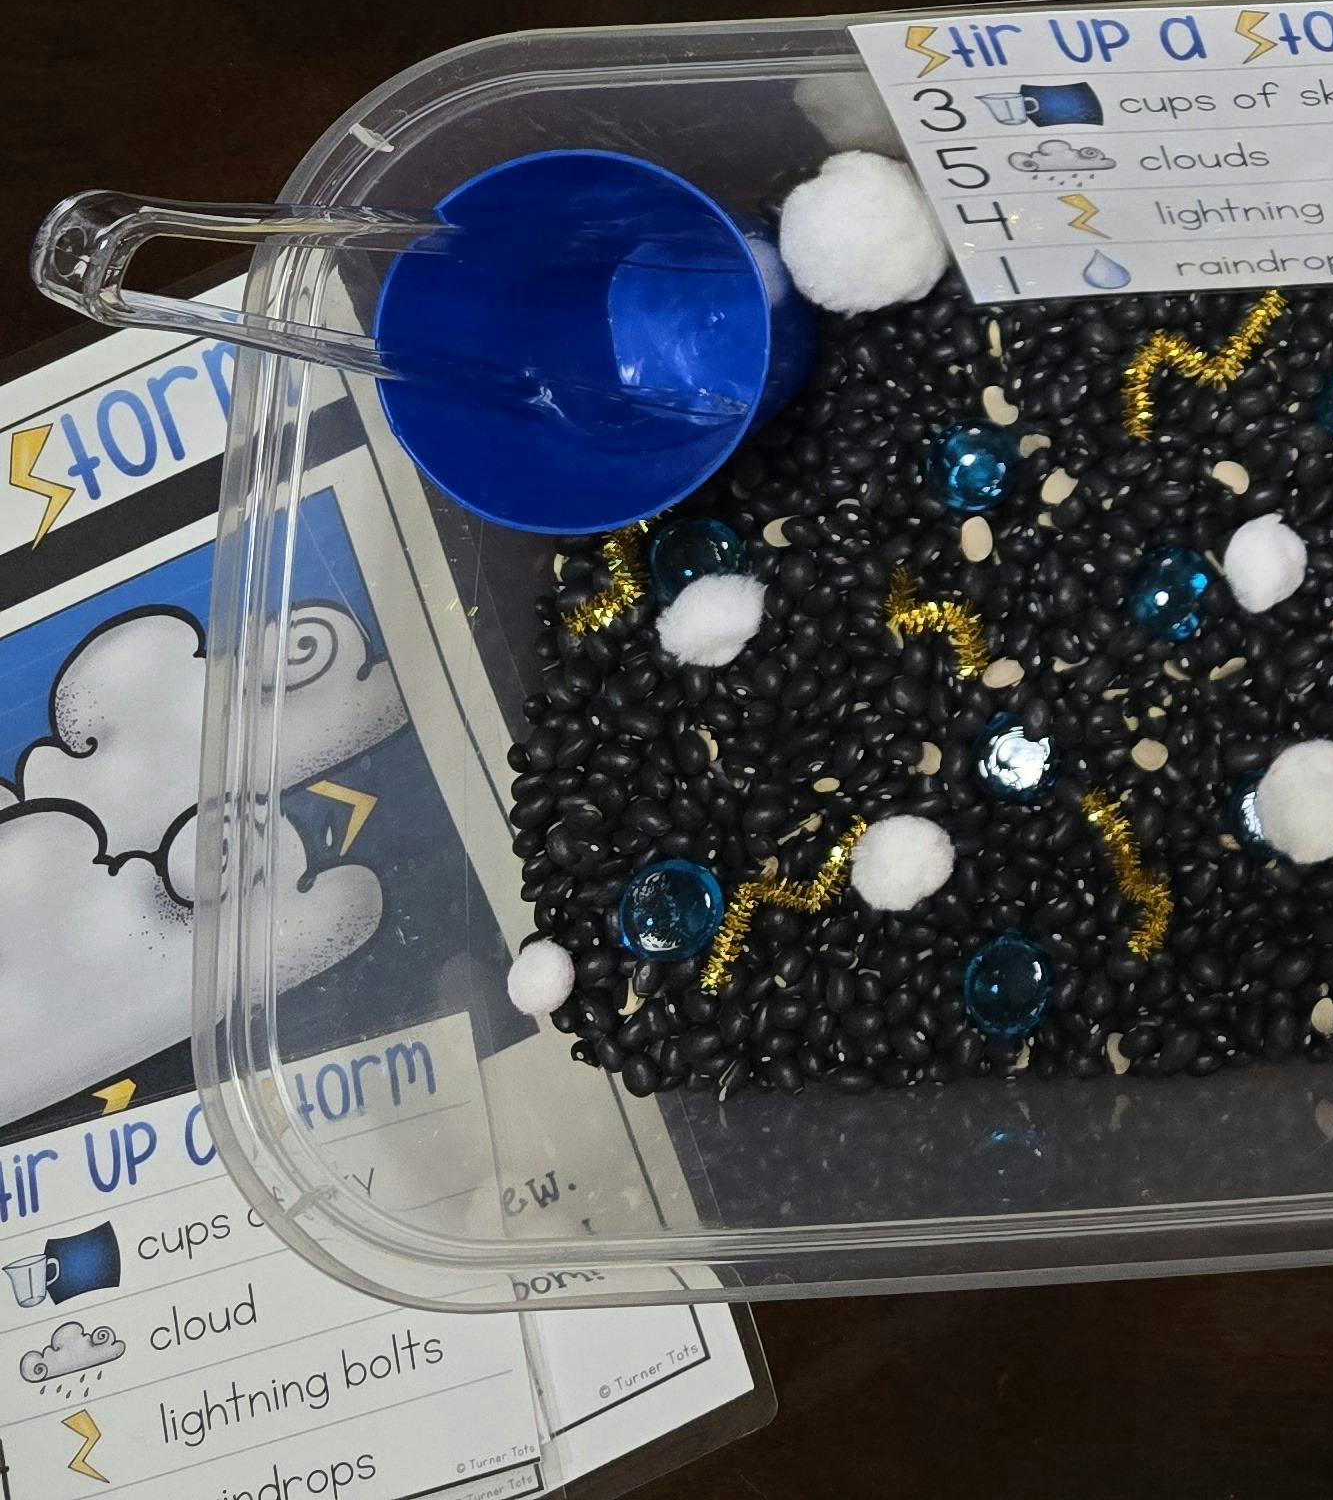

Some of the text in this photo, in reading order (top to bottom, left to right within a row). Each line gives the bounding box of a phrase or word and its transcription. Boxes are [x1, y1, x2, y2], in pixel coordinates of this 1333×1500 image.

[913, 88, 967, 132] 3
[1119, 94, 1217, 119] cups
[1233, 82, 1279, 110] of
[936, 142, 1271, 190] 5 clouds
[956, 200, 1014, 241] 4
[1154, 198, 1325, 231] lightning
[999, 256, 1021, 295] 1
[138, 1214, 231, 1260] cups
[150, 1283, 257, 1350] cloud
[160, 1329, 444, 1447] lightning bolts
[614, 1361, 663, 1392] Turner
[665, 1342, 699, 1366] Tots
[469, 1452, 508, 1471] Turner
